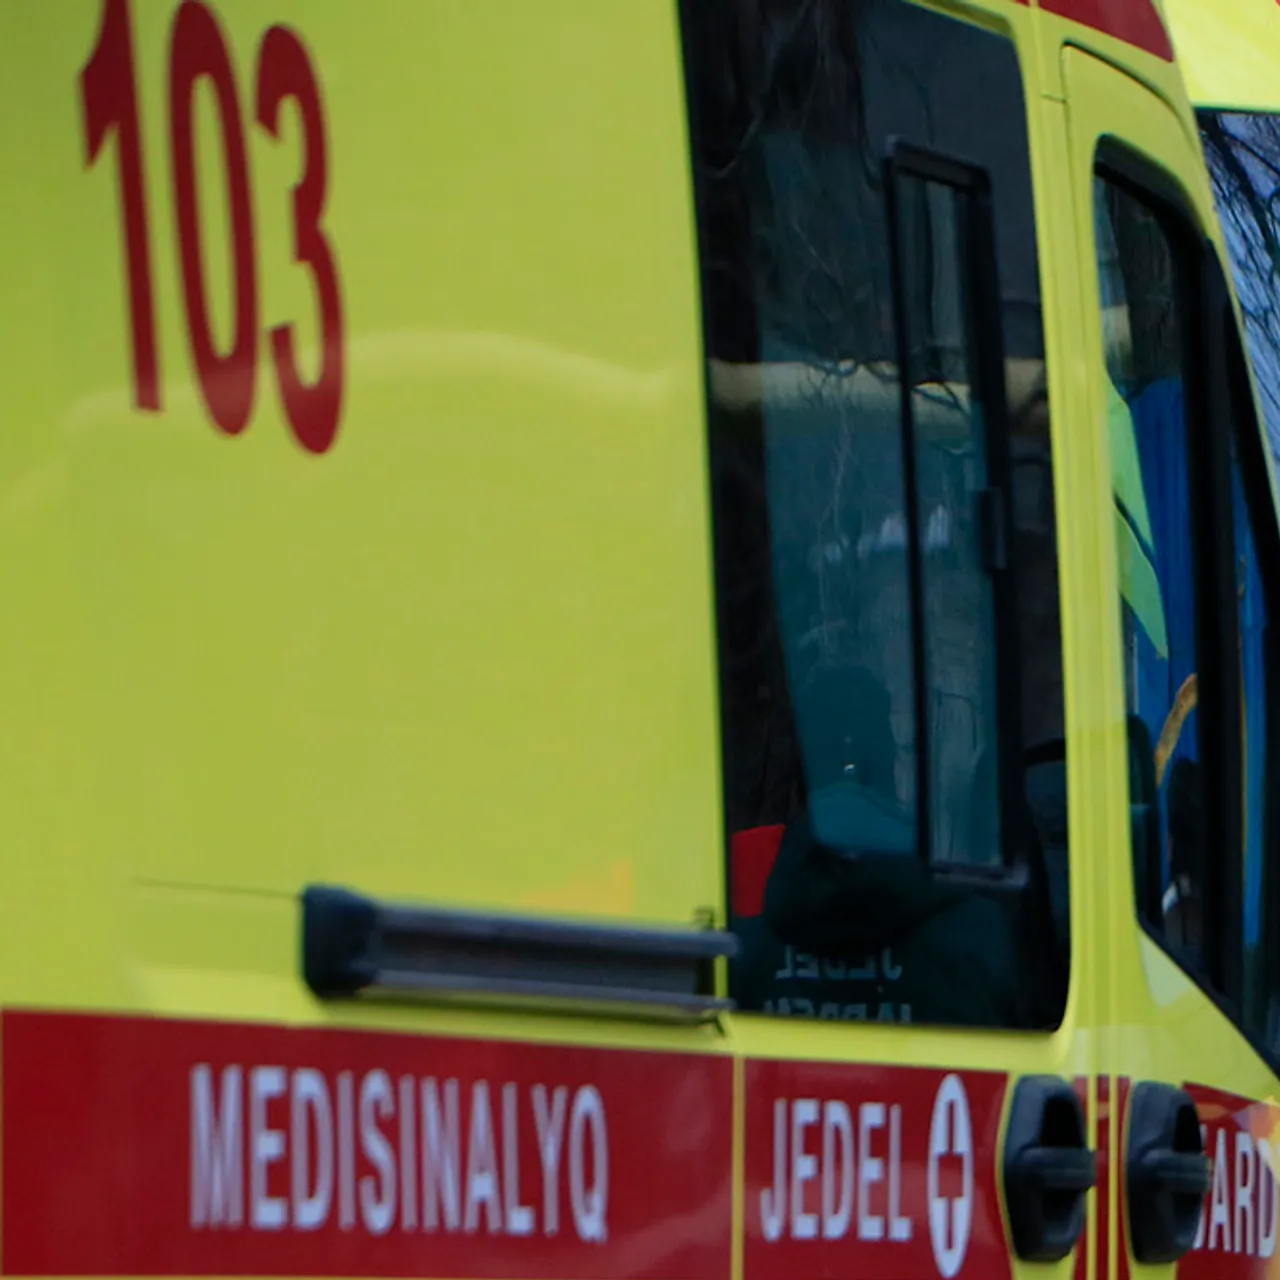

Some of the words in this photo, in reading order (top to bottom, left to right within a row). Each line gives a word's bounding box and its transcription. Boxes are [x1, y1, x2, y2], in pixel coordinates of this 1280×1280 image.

[77, 0, 346, 456] 103
[189, 1063, 609, 1243] MEDISINALYQ
[760, 1097, 913, 1242] JEDEL
